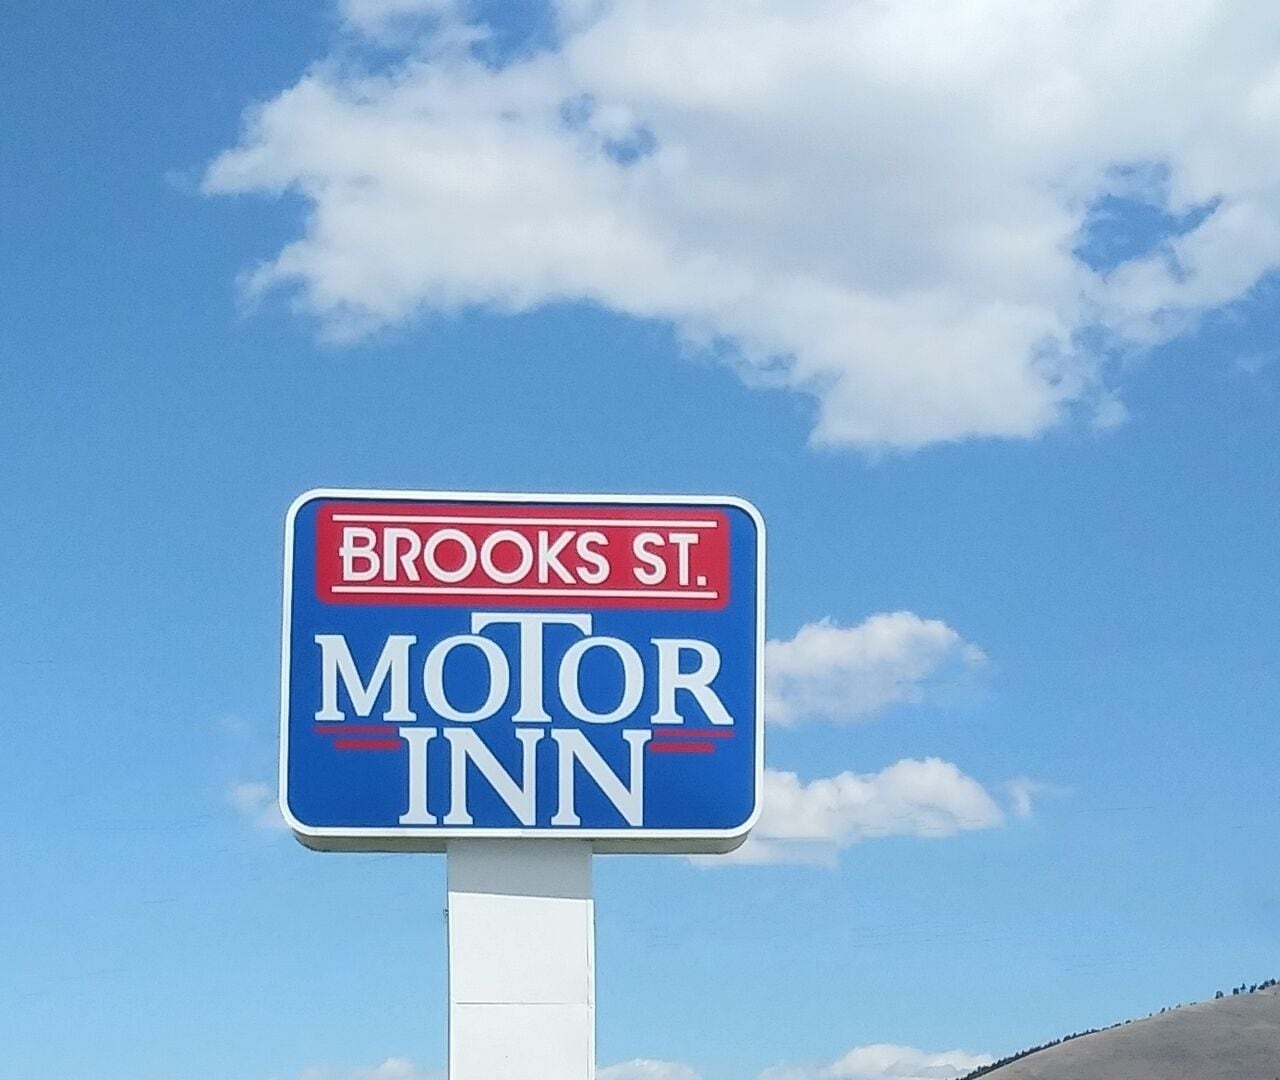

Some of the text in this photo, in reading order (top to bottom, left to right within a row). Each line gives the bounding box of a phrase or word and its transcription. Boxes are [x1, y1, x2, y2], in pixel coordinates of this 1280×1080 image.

[339, 526, 706, 587] BROOKS ST.
[314, 612, 734, 726] MOTOR
[398, 727, 652, 827] INN
